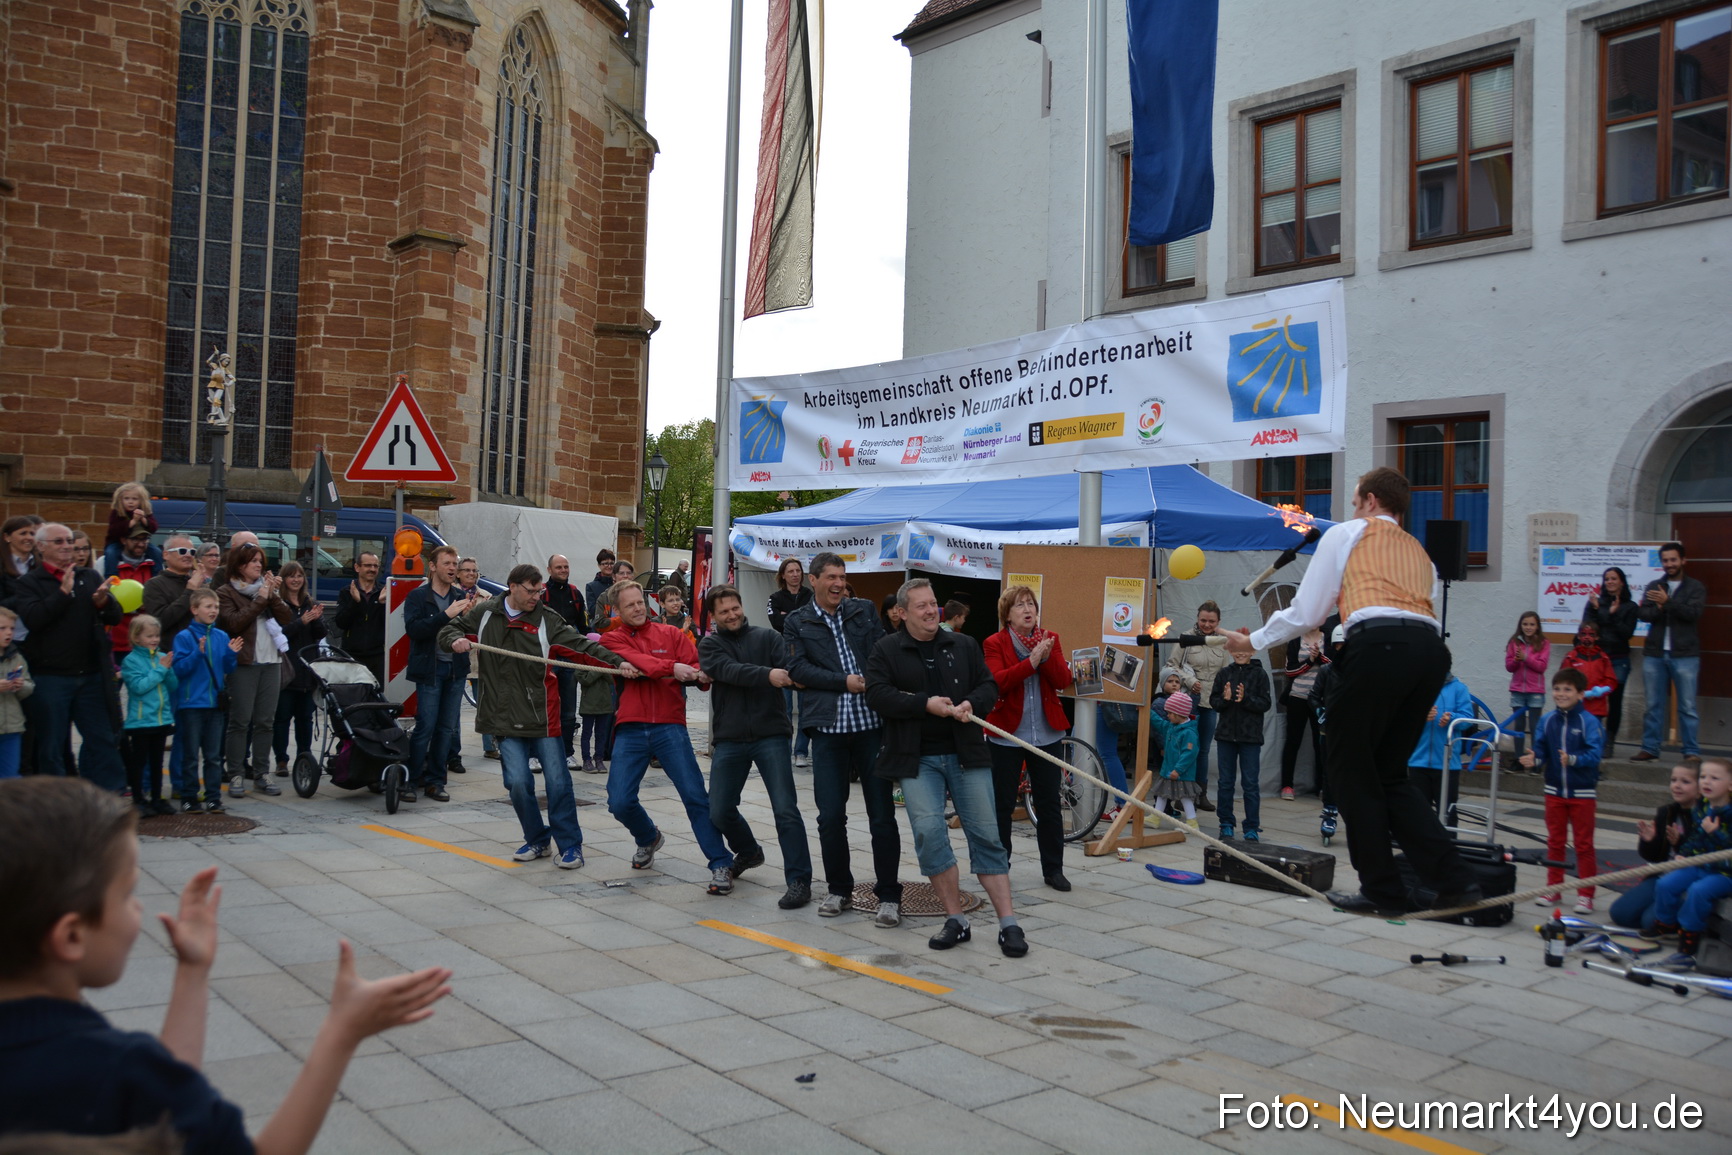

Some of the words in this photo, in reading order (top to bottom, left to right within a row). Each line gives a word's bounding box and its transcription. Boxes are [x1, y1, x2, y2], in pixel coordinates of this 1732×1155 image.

[803, 374, 953, 409] Arbeitsgemeinschaft
[959, 367, 1013, 390] offene
[1019, 331, 1193, 378] Behindertenarbeit
[858, 414, 876, 430] im
[881, 405, 956, 428] Landkreis
[961, 387, 1034, 418] Neumarkt
[963, 424, 993, 437] Diakonie
[1047, 425, 1077, 440] Regens
[1079, 420, 1117, 435] Wagner
[861, 438, 904, 448] Bayerisches
[963, 435, 1003, 449] Nürnberger
[1004, 433, 1021, 444] Land
[858, 448, 878, 456] Rotes
[921, 444, 955, 454] Sozialstation
[963, 449, 996, 461] Neumarkt
[858, 457, 876, 466] Kreuz
[918, 454, 947, 464] Neumarkt
[758, 537, 779, 547] Bunte
[782, 538, 823, 548] Mit-Mach
[827, 536, 875, 549] Angebote
[947, 537, 993, 550] Aktionen
[1010, 575, 1040, 583] URKUNDE
[1109, 579, 1142, 587] URKUNDE
